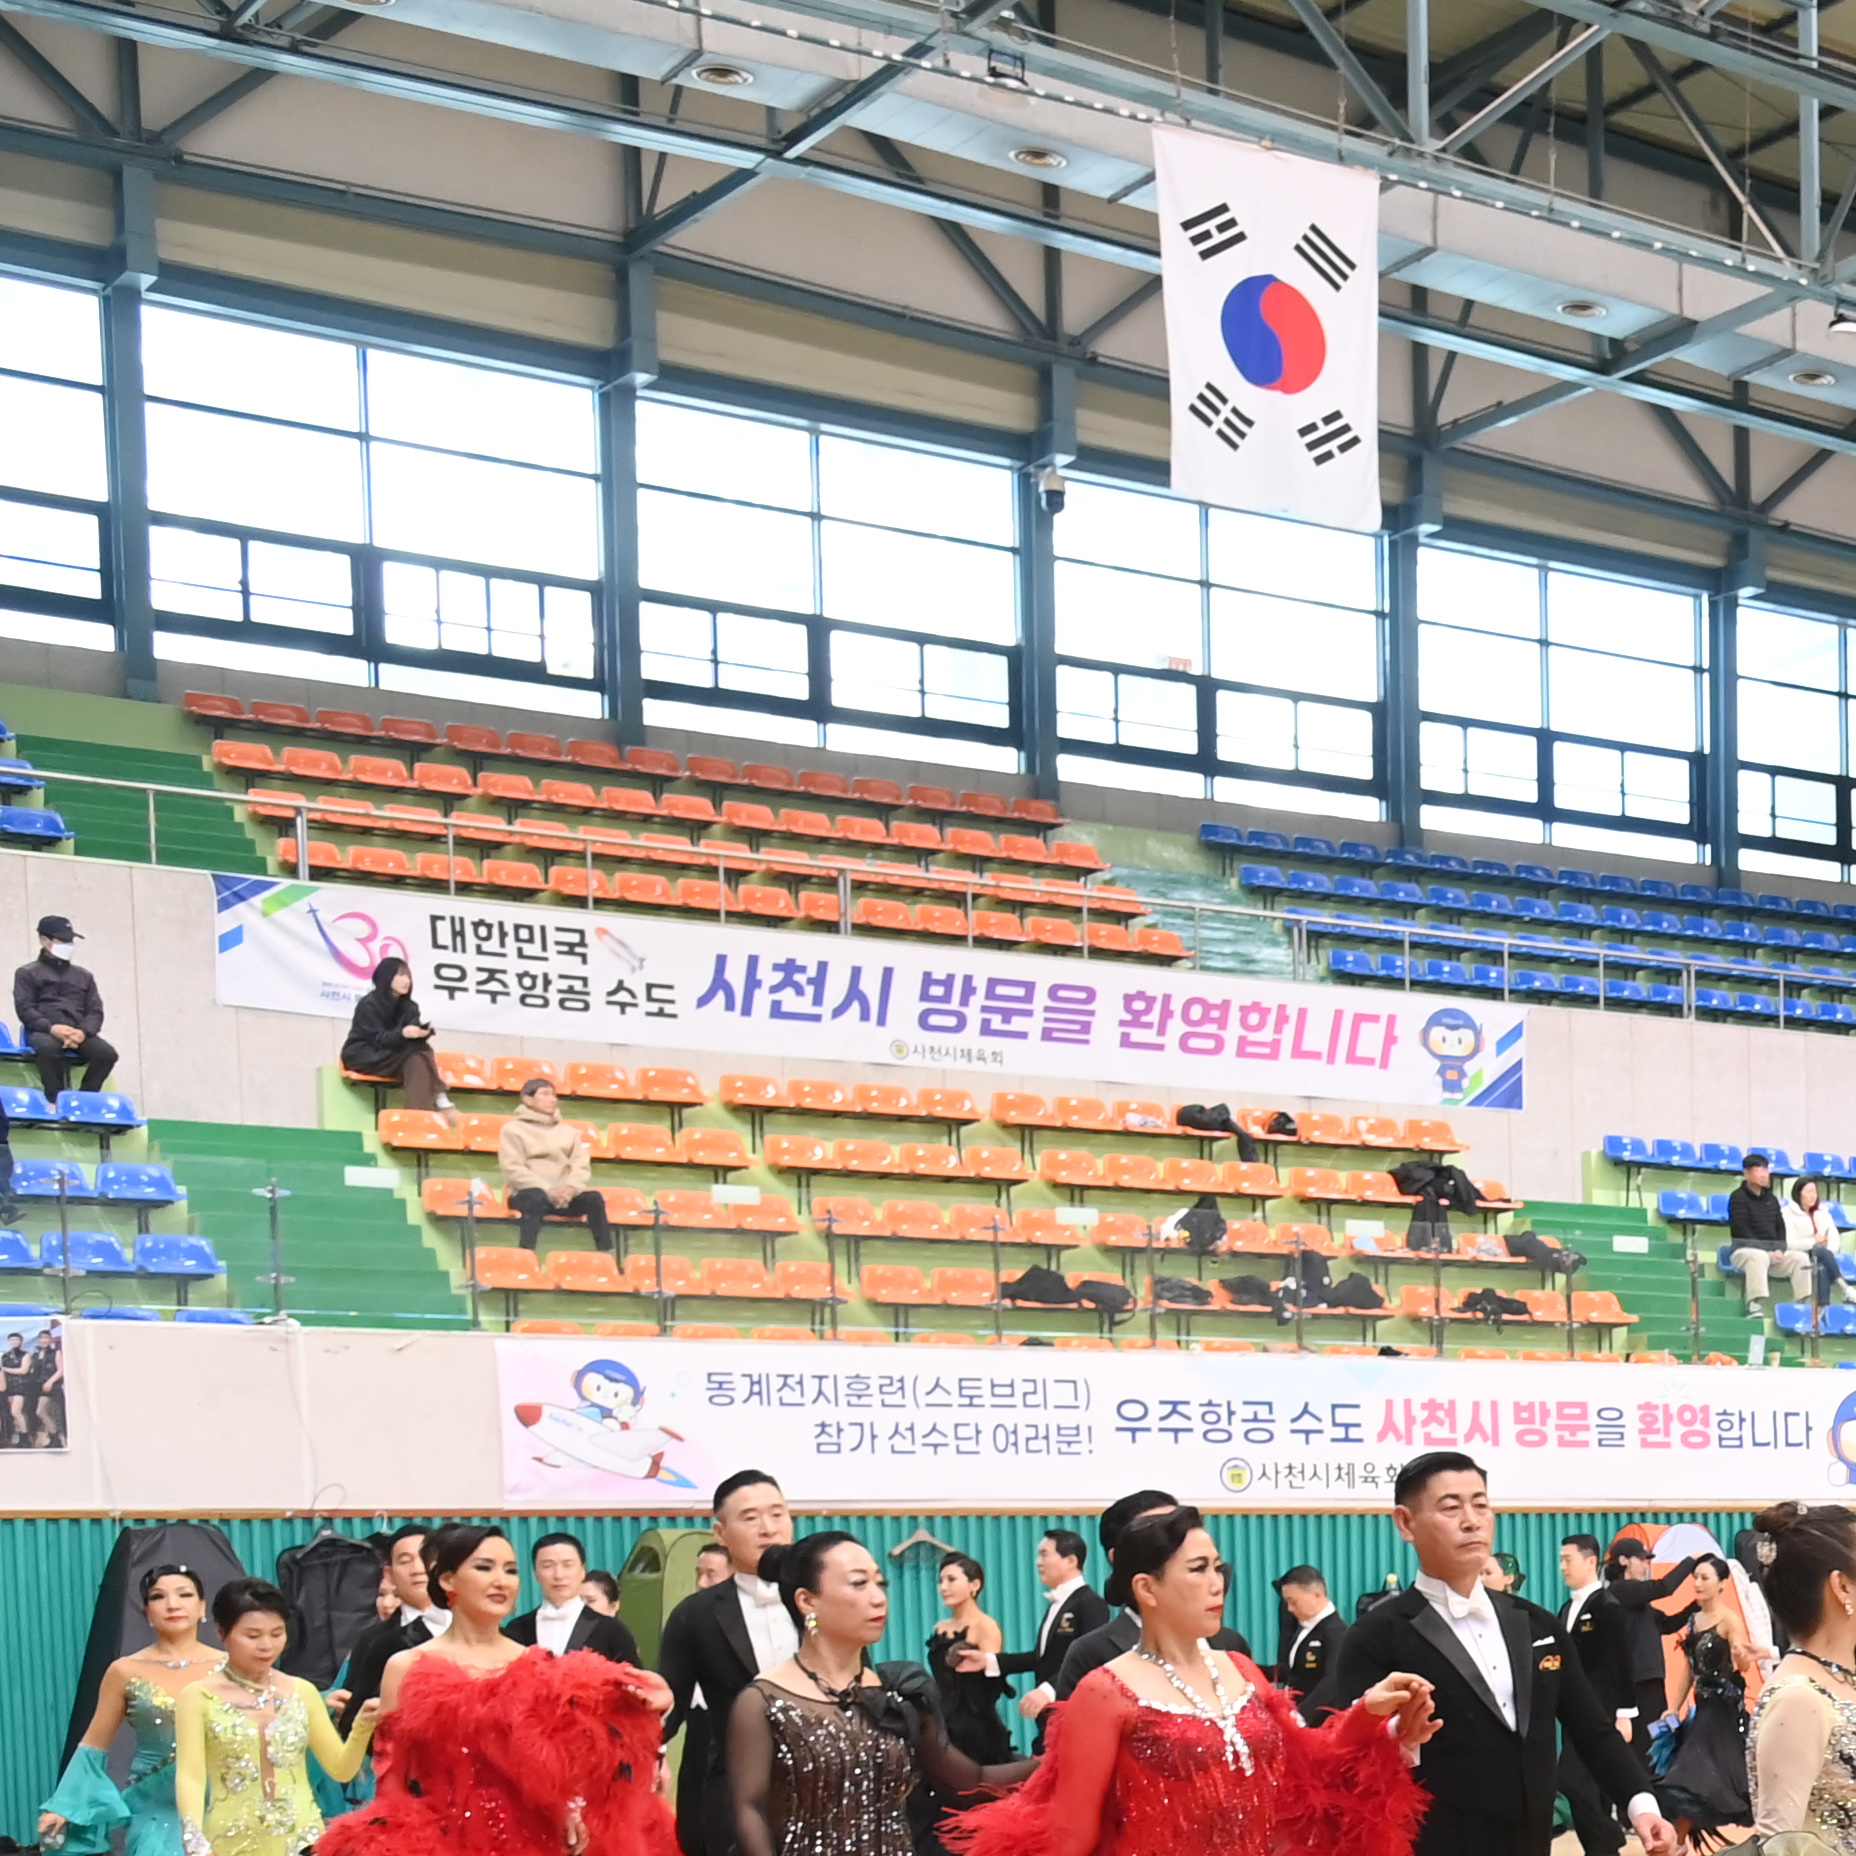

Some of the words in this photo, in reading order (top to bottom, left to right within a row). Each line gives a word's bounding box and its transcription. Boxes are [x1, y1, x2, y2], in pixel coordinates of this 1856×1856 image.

[429, 914, 589, 965] 대한민국
[433, 962, 592, 1013] 우주항공
[605, 979, 679, 1019] 수도
[696, 953, 894, 1028] 사천시
[917, 971, 1097, 1046] 방문을
[1118, 990, 1399, 1071] 환영합니다
[912, 1044, 1004, 1066] 사천시체육회
[705, 1371, 1092, 1413] 동계전지훈련(스토브리그)
[813, 1420, 878, 1455] 참가
[888, 1421, 982, 1456] 선수단
[992, 1422, 1093, 1457] 여러분!
[1115, 1399, 1276, 1445] 우주항공
[1289, 1401, 1364, 1446] 수도
[1376, 1398, 1501, 1448] 사천시
[1512, 1400, 1626, 1449] 방문을
[1636, 1402, 1813, 1450] 환영합니다
